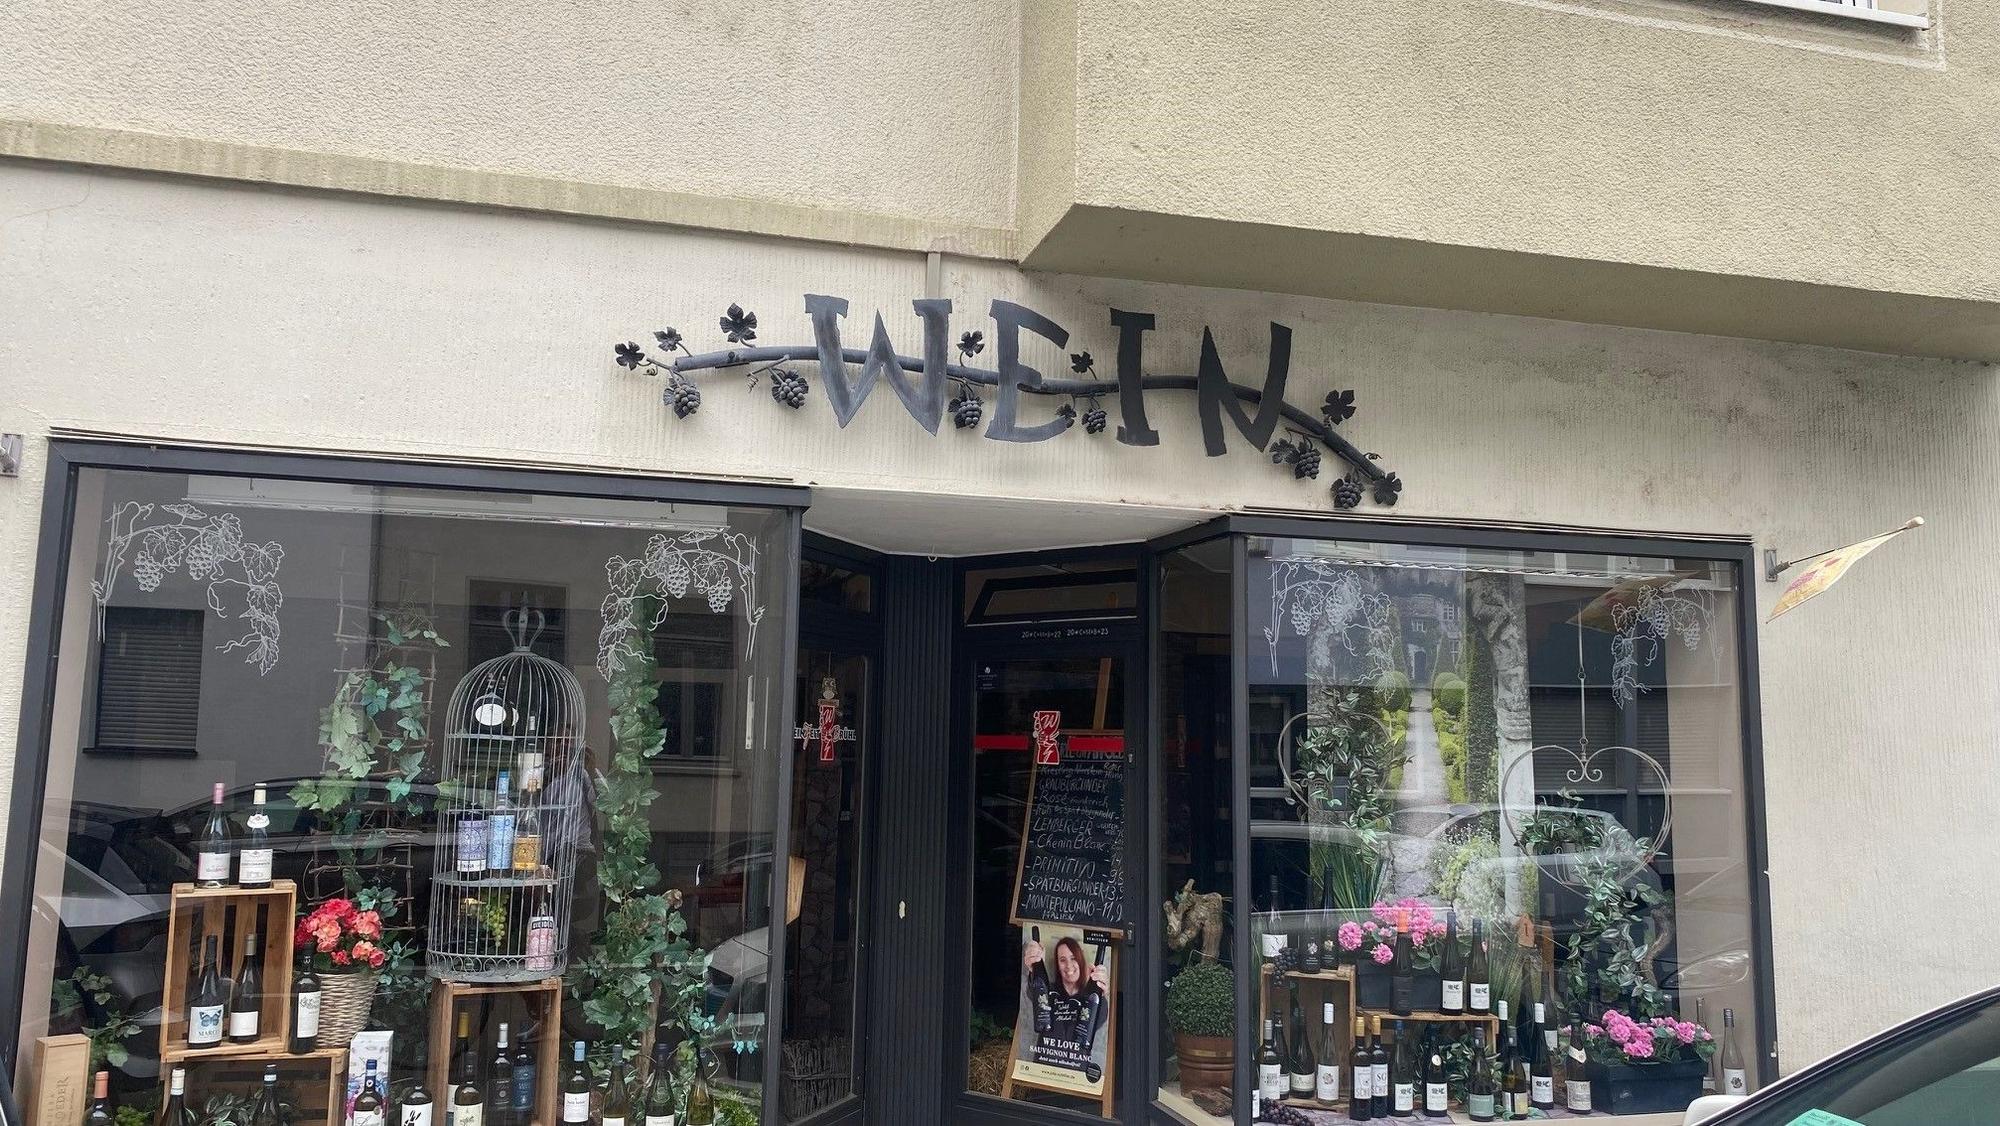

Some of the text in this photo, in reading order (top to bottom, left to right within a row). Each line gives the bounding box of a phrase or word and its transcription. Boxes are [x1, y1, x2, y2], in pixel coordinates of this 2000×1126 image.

[804, 294, 1292, 457] WEIN
[1043, 1037, 1080, 1051] WE LOVE
[1029, 1045, 1093, 1062] SAUVIGNON BLANC
